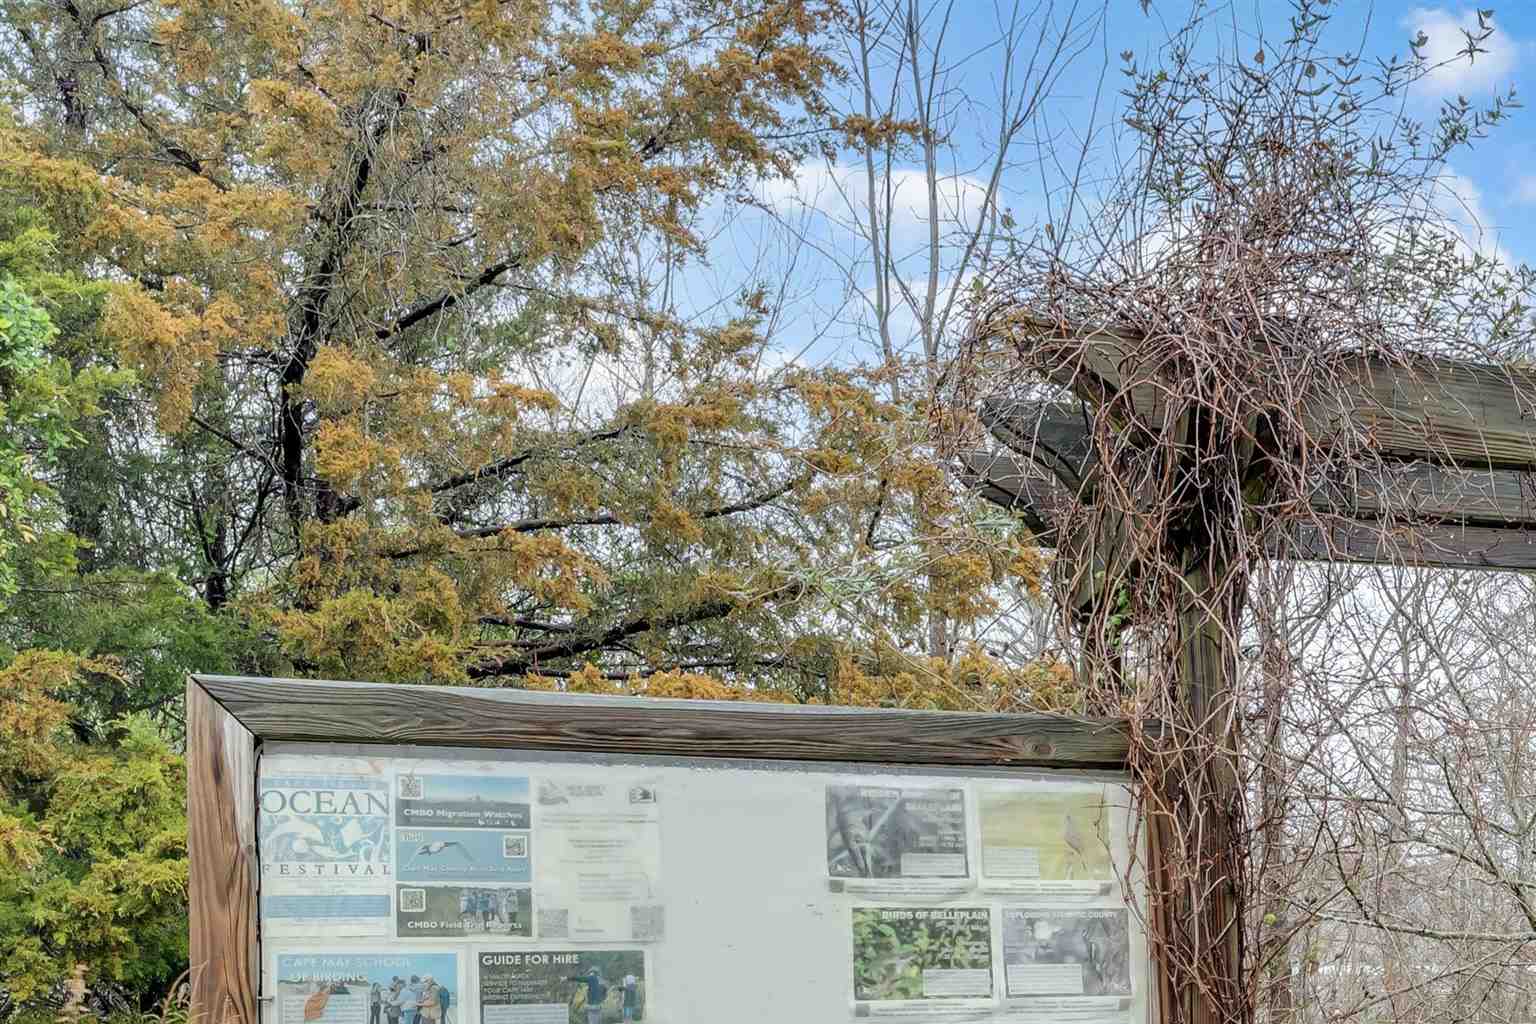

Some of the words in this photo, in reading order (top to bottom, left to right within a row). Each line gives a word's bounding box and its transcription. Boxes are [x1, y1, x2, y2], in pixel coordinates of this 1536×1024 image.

[260, 789, 391, 816] OCEAN
[261, 863, 392, 876] FESTIVAL
[481, 954, 522, 966] GUIDE
[524, 953, 549, 965] FOR
[552, 953, 580, 964] HIRE
